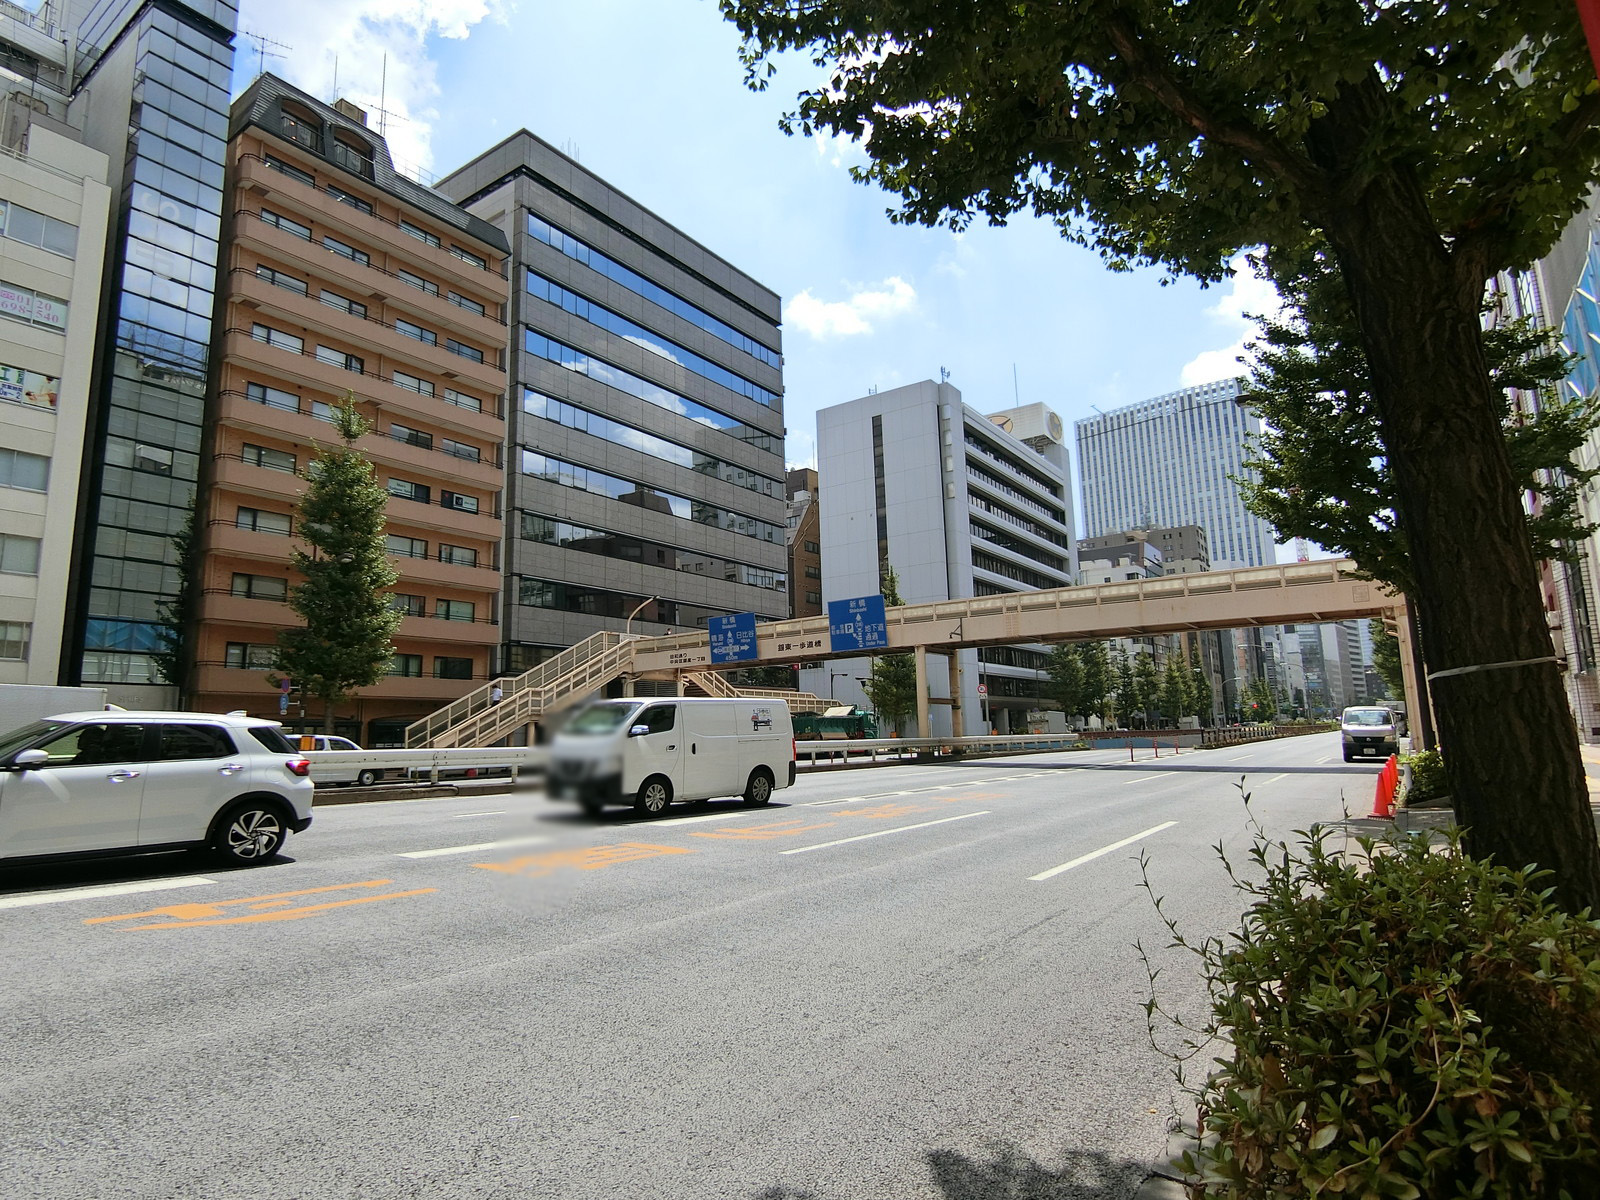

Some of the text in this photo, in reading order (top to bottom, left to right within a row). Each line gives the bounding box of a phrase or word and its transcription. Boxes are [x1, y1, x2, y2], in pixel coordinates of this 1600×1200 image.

[17, 295, 52, 311] 0120
[849, 599, 865, 608] 新橋
[721, 616, 736, 624] 新橋
[865, 623, 884, 632] 地下道
[736, 630, 754, 639] 日比谷
[865, 632, 878, 640] 通過
